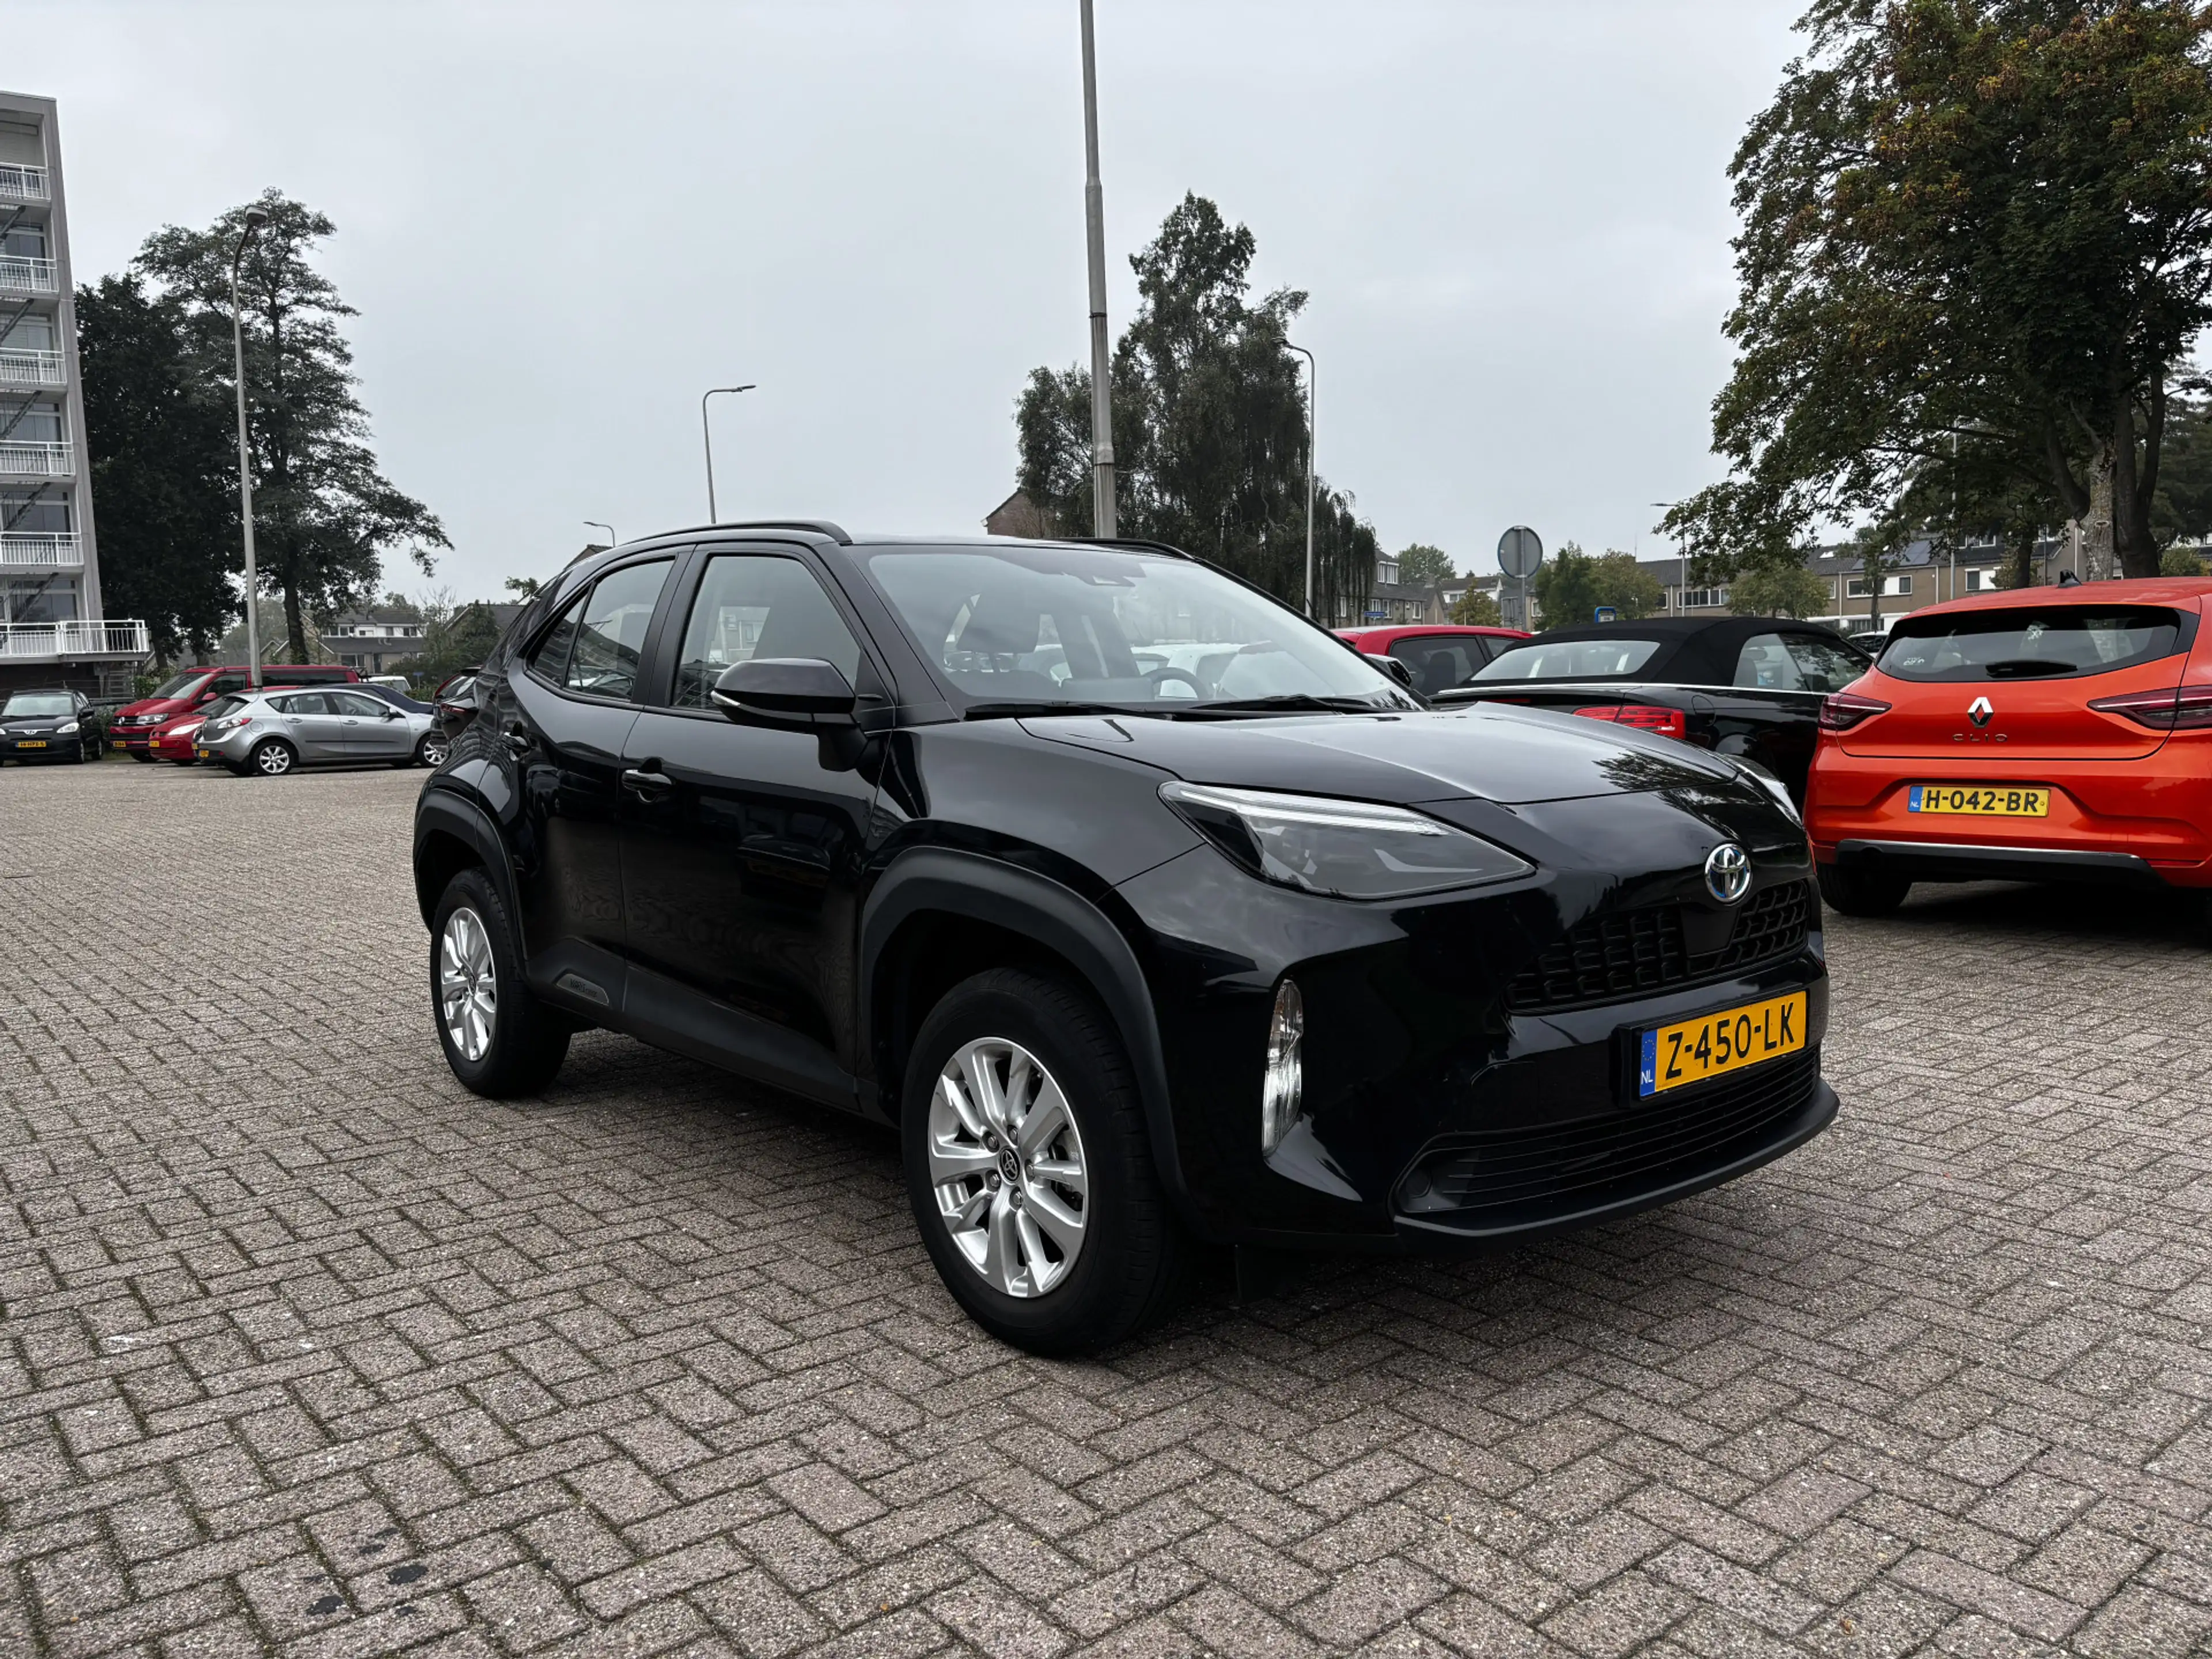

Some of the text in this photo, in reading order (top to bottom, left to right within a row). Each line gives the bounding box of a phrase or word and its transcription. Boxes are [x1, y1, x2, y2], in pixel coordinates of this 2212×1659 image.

[1953, 733, 2008, 742] CLIO
[1926, 790, 2039, 812] H-042-BR
[1641, 1002, 1794, 1085] NL Z-450-LK
